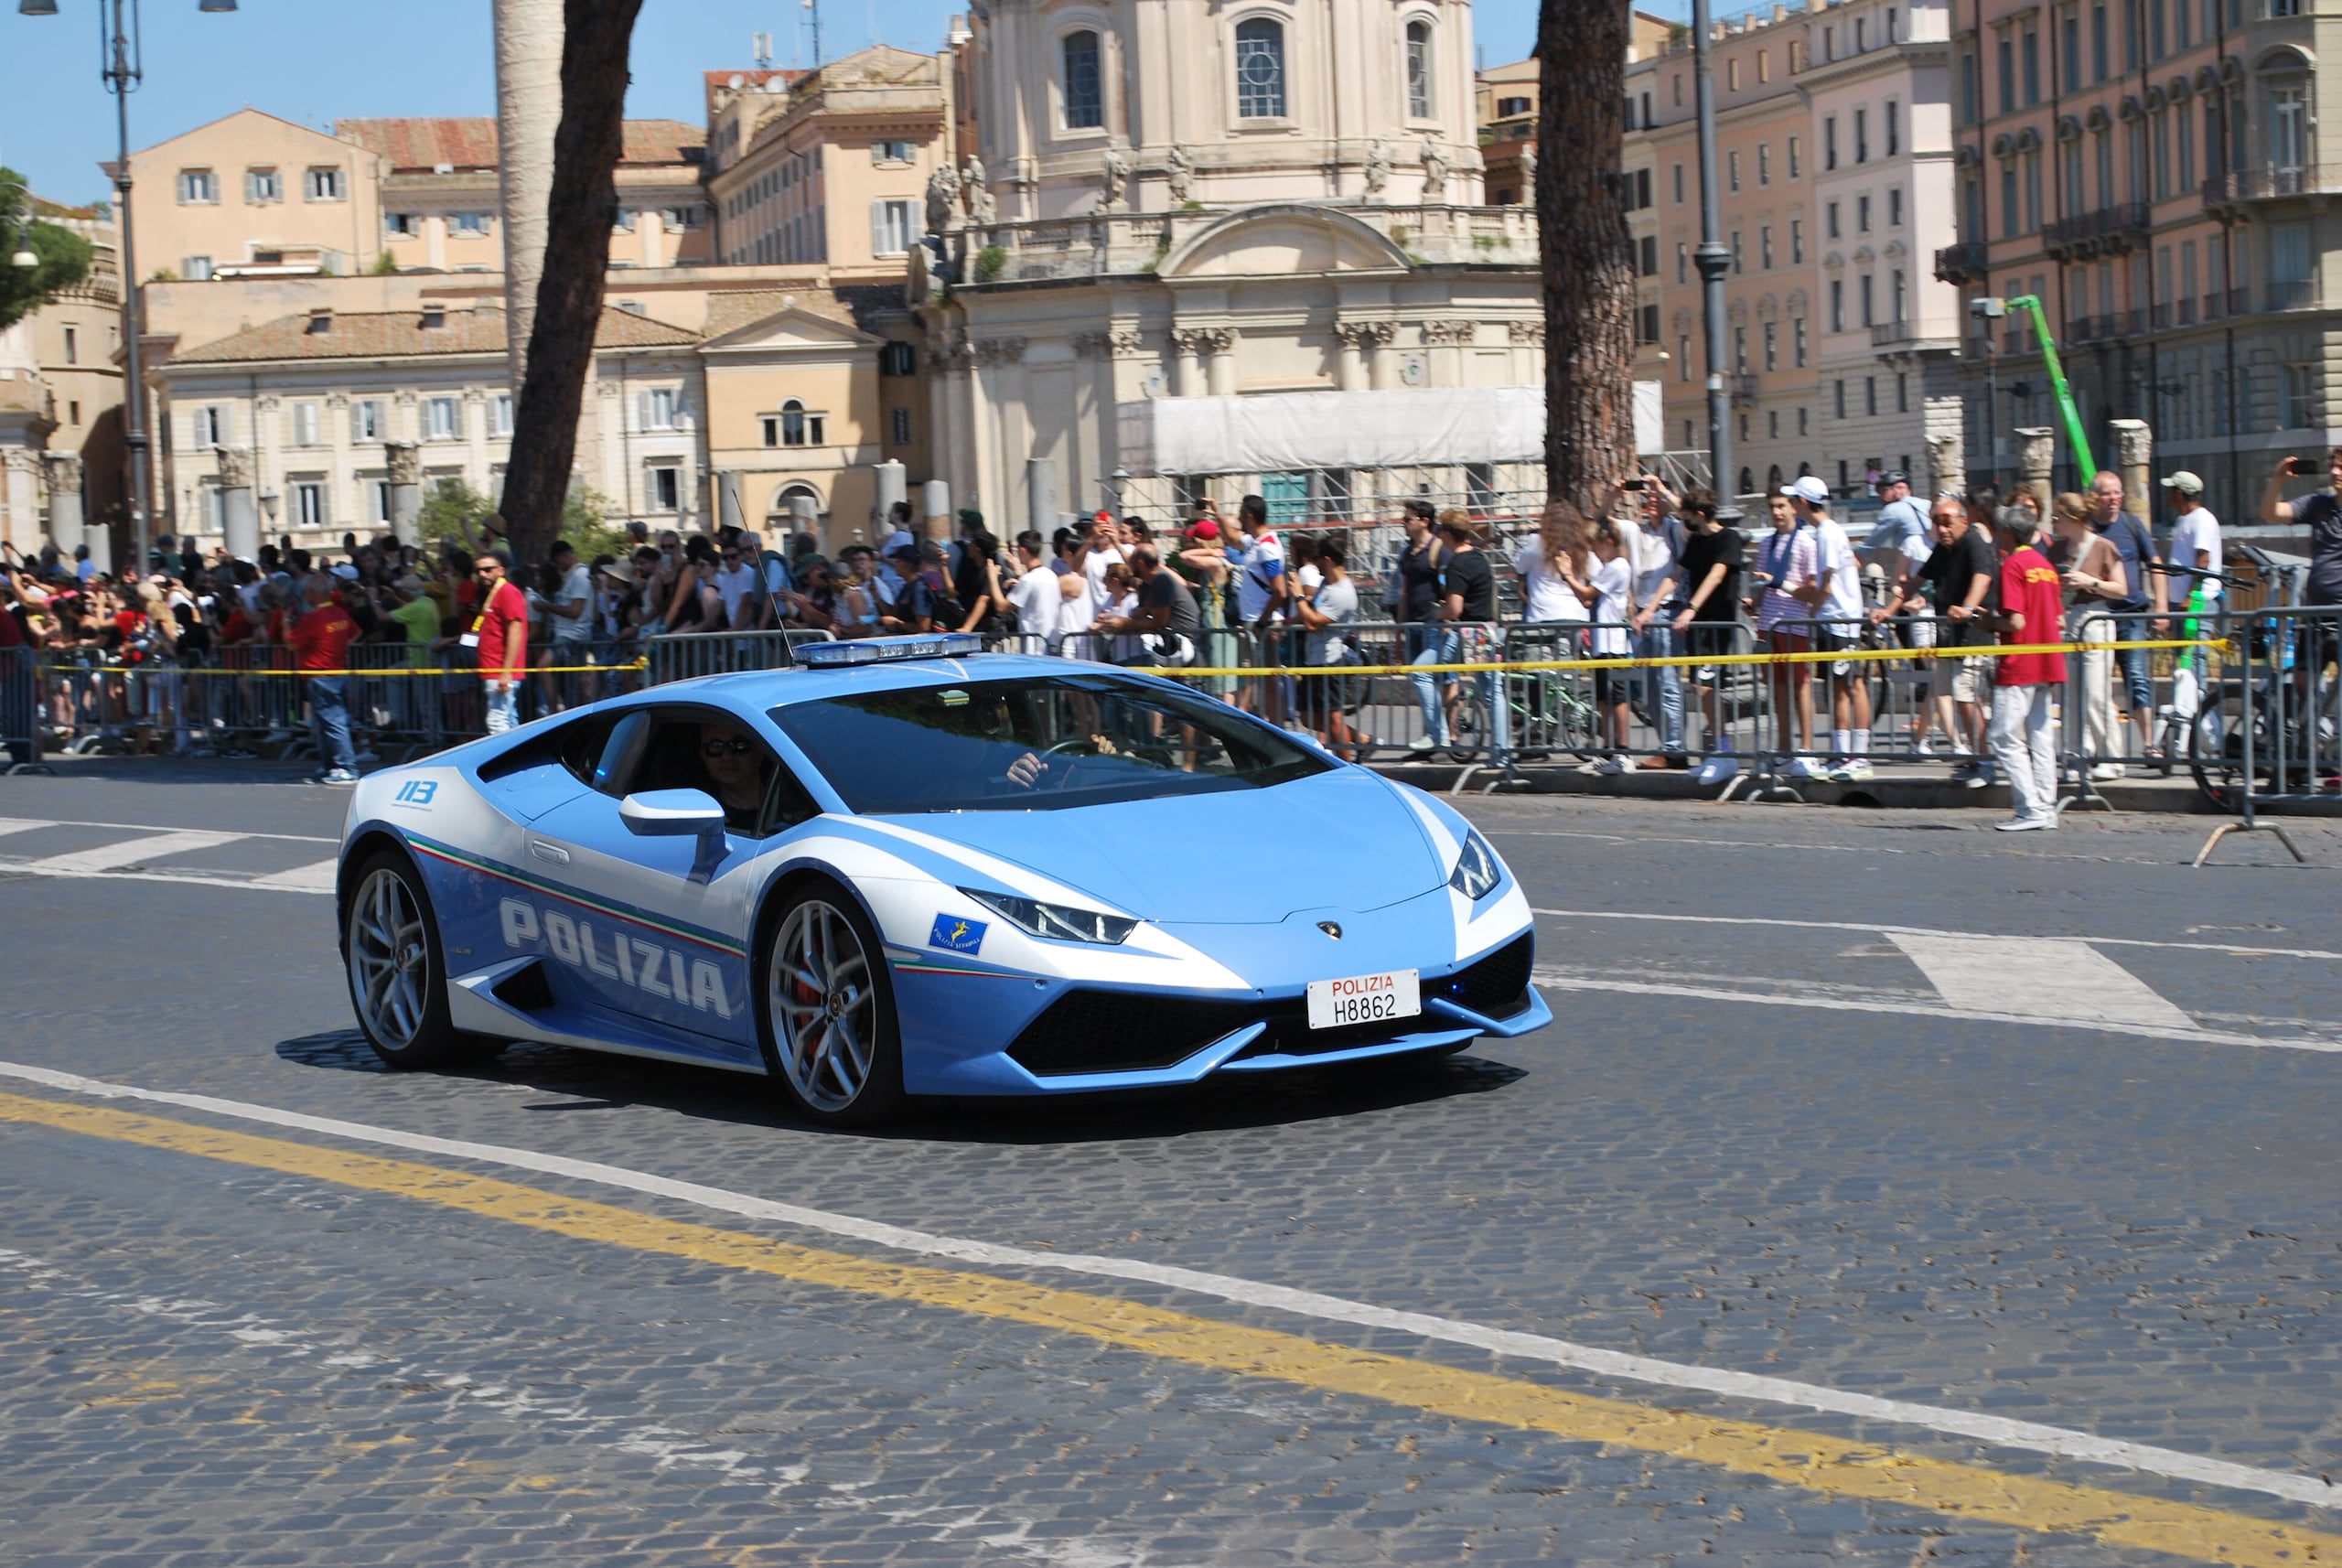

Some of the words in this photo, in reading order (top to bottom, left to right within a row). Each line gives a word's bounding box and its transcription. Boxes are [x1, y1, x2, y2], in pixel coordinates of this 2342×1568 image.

[395, 780, 438, 804] 113
[499, 897, 732, 1020] POLIZIA
[1332, 975, 1394, 996] POLIZIA
[1334, 993, 1396, 1024] H8862
